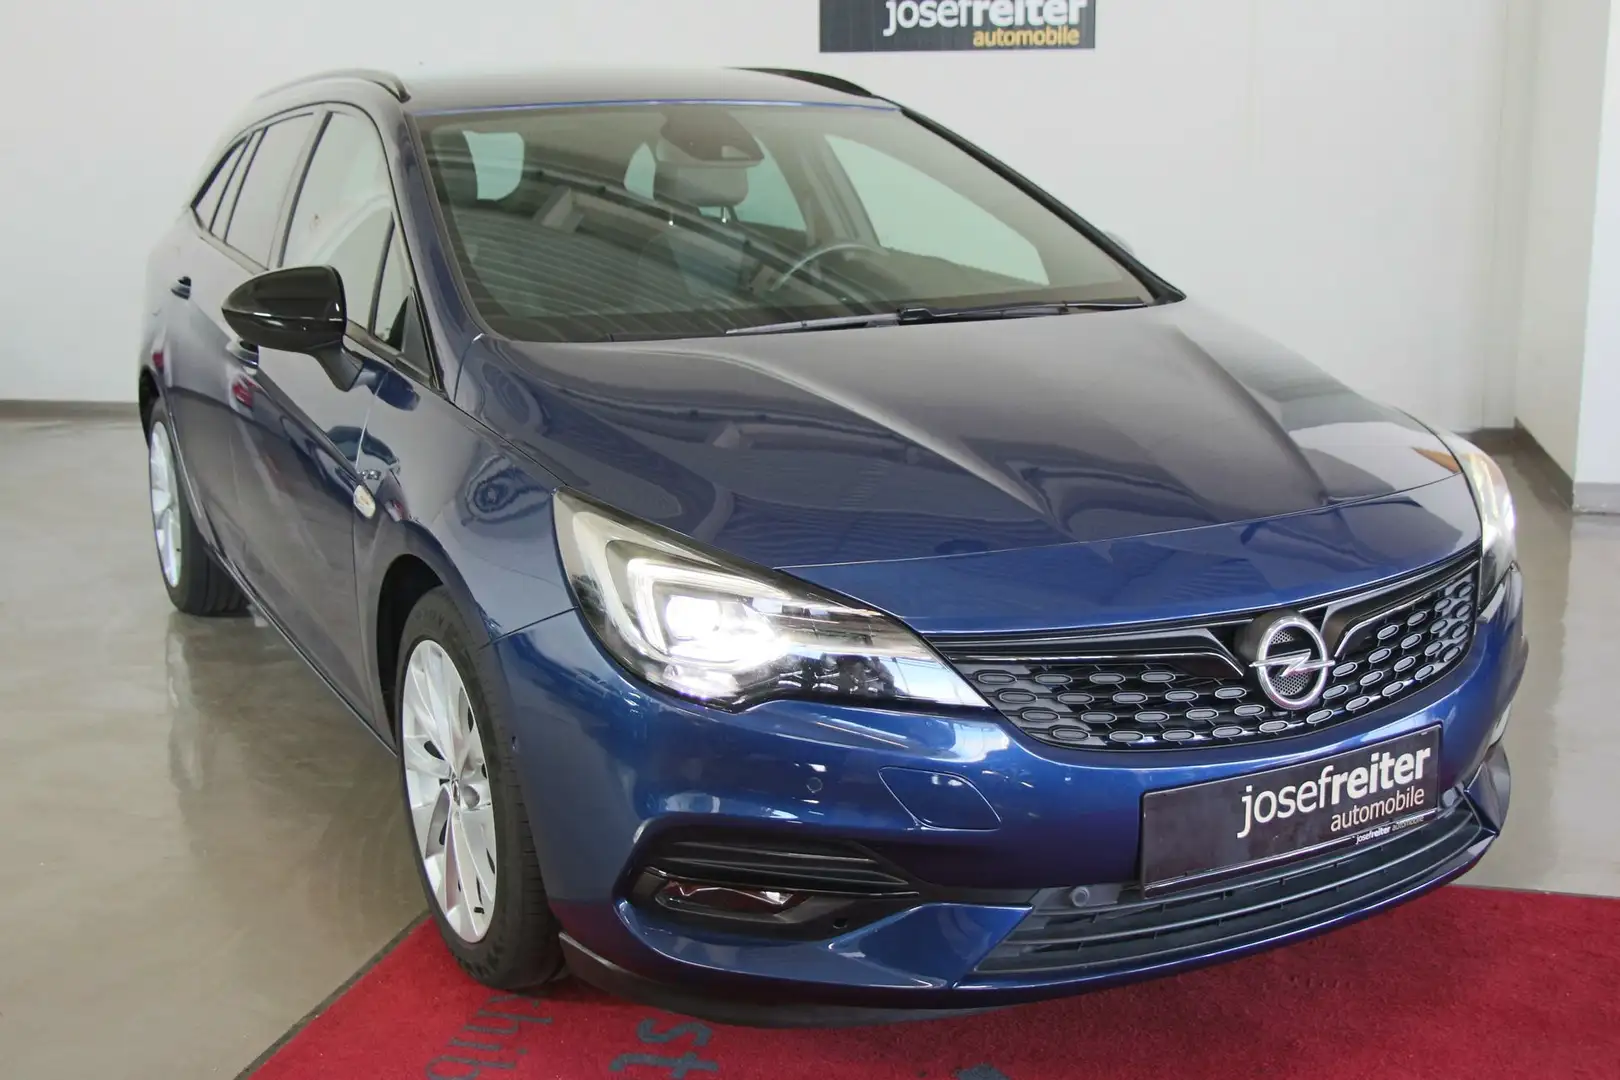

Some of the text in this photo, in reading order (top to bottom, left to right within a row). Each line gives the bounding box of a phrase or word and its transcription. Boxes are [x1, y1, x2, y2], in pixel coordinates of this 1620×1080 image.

[883, 0, 1086, 36] josefreiter
[973, 26, 1080, 47] automobile
[1237, 747, 1431, 838] josefreiter
[1330, 785, 1425, 831] automobile
[1355, 825, 1391, 845] josefreiter
